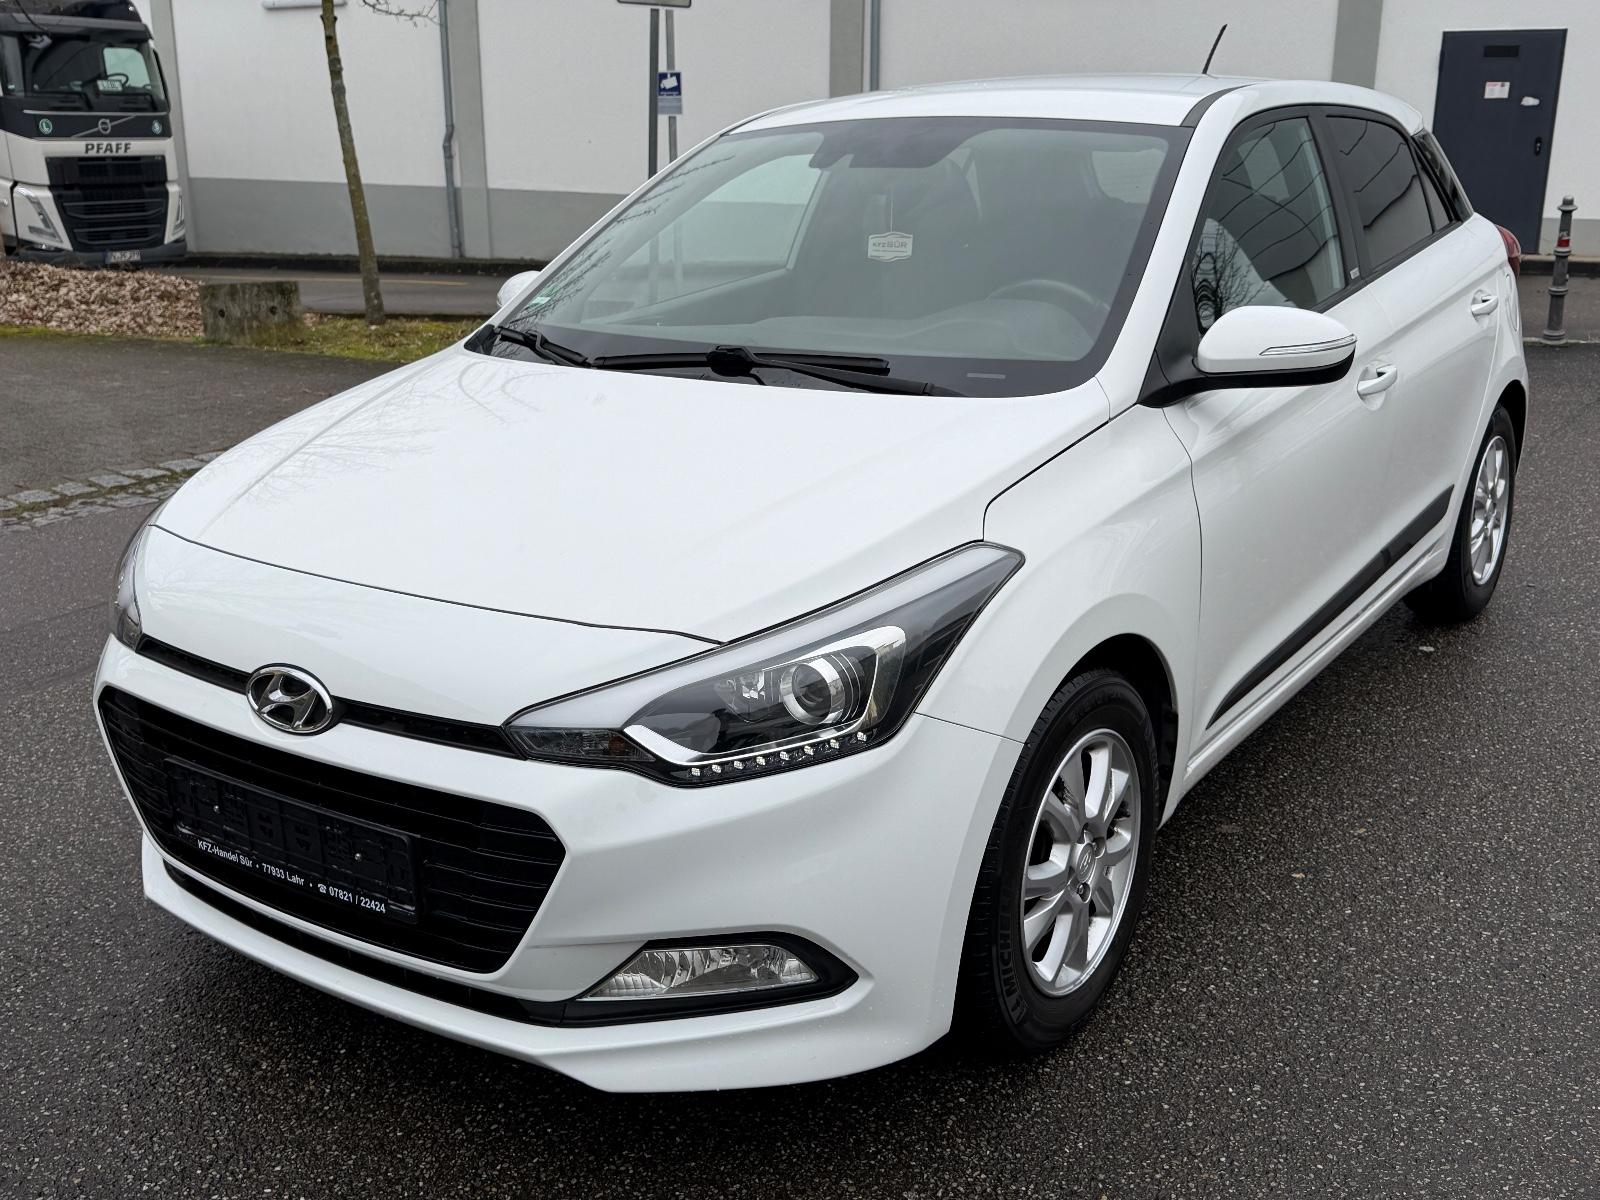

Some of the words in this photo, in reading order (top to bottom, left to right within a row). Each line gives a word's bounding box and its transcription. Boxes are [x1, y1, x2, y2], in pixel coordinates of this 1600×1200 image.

[84, 143, 132, 154] PFAFF
[197, 840, 239, 863] KFZ-Handel
[240, 855, 253, 868] Sür
[262, 863, 285, 879] 77933
[286, 871, 304, 886] Lahr
[329, 886, 352, 903] 07821
[360, 896, 386, 914] 22424
